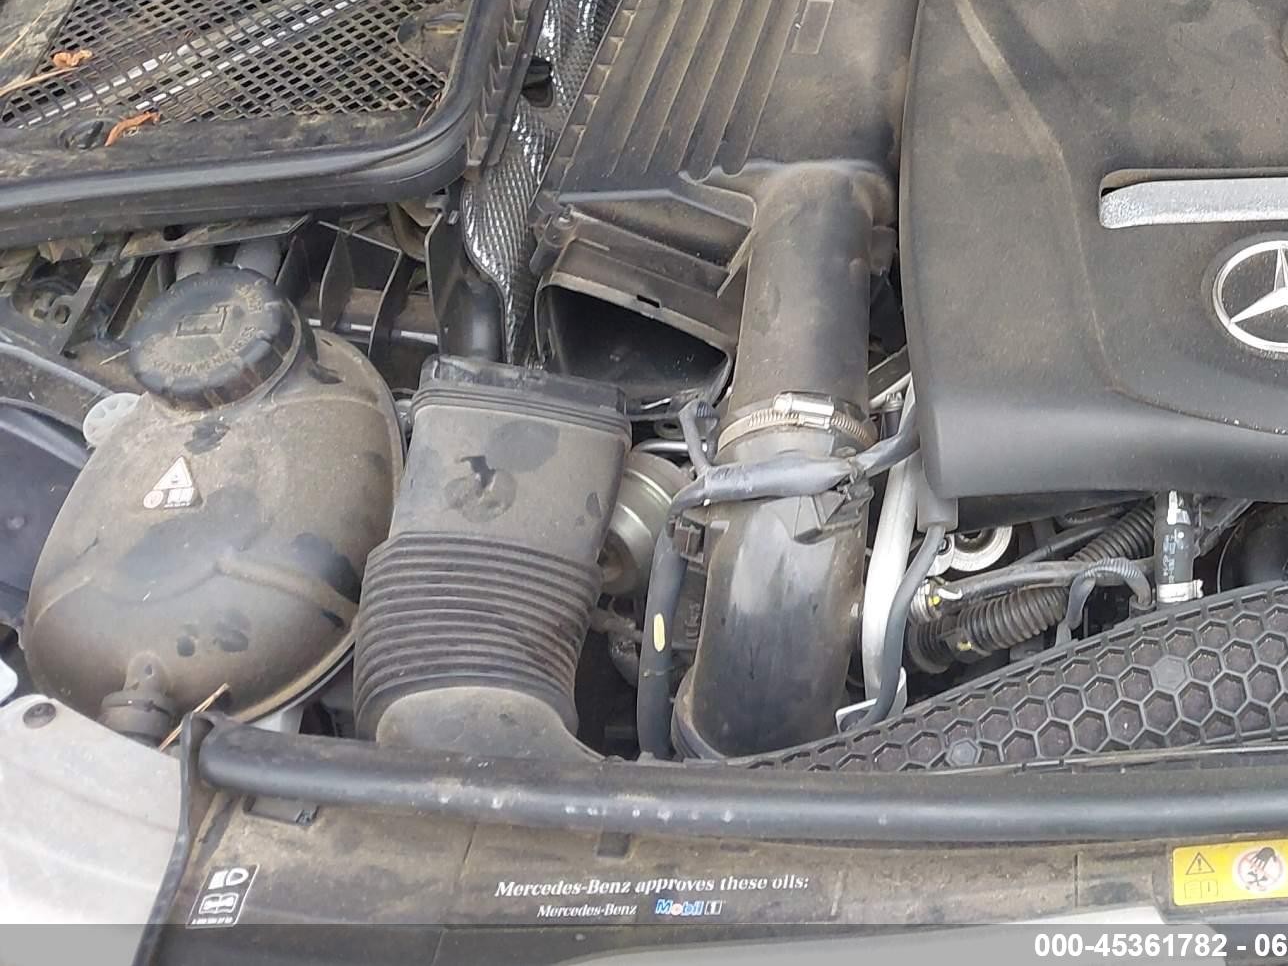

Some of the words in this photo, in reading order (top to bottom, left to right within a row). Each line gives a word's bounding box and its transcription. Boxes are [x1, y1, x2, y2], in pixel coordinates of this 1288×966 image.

[494, 880, 631, 898] Mercedes-Benz
[635, 877, 715, 895] approves
[720, 875, 767, 891] these
[537, 903, 637, 918] Mercedes-Benz
[655, 899, 705, 916] Mobil
